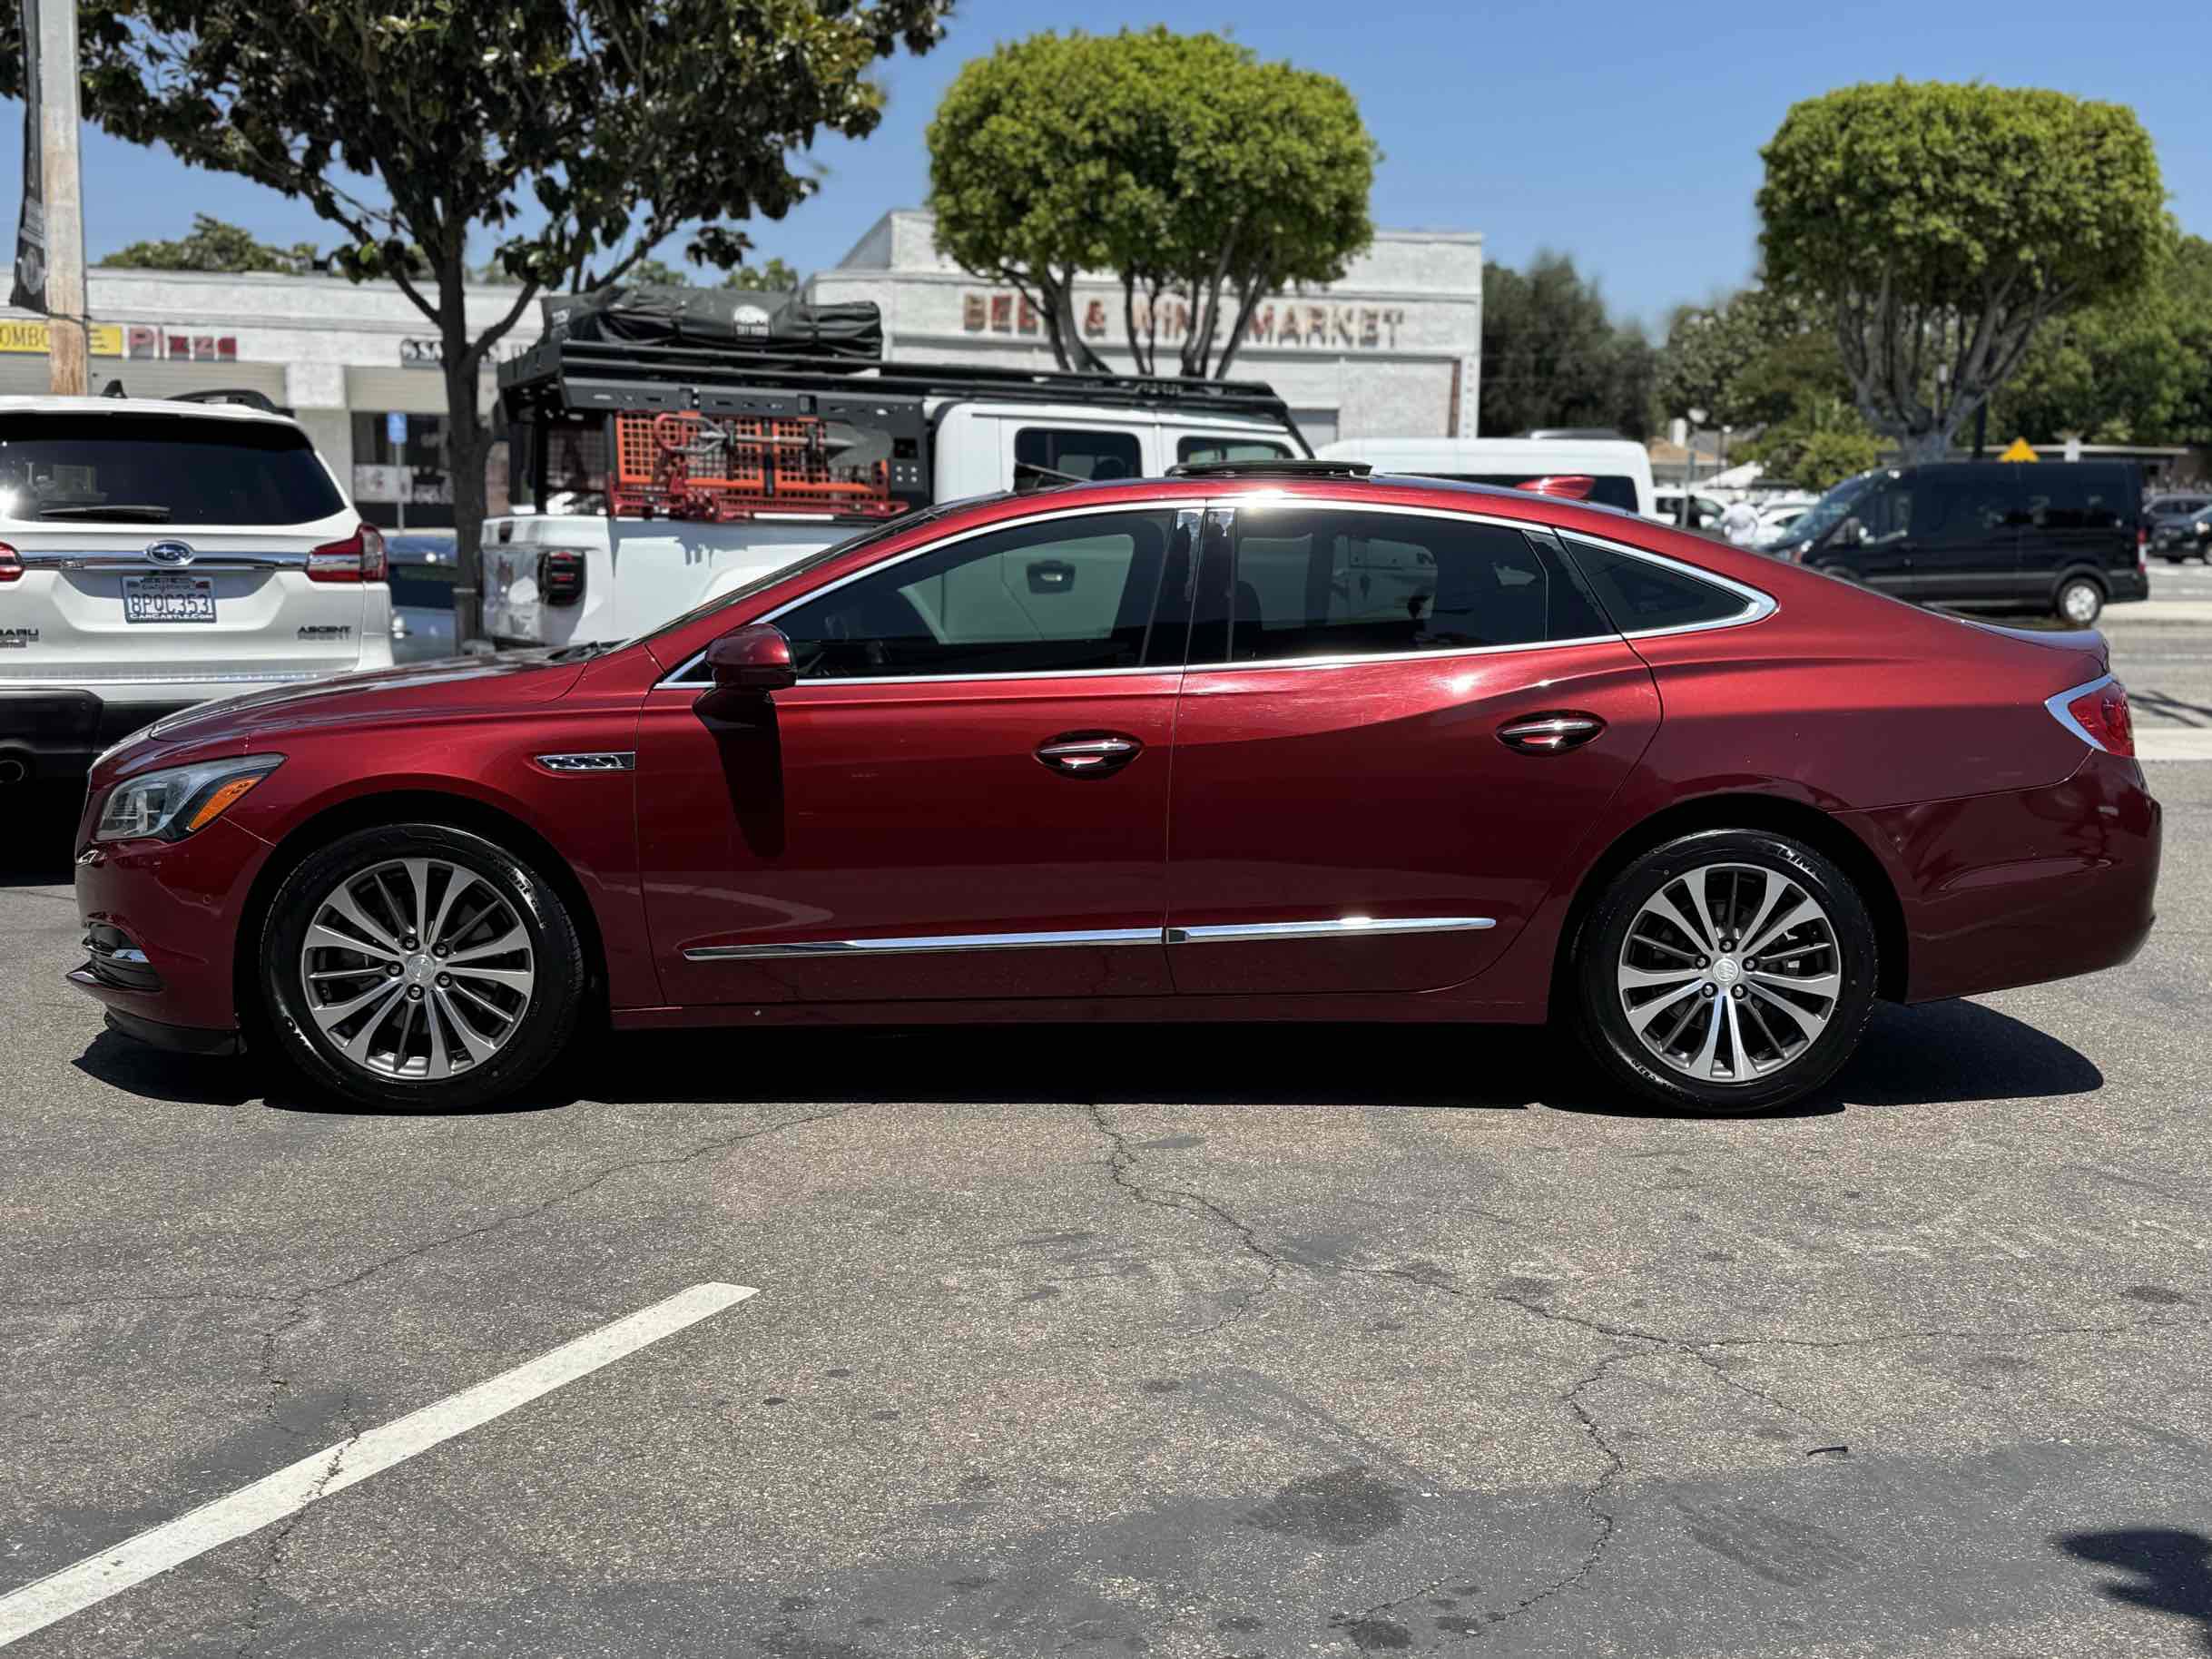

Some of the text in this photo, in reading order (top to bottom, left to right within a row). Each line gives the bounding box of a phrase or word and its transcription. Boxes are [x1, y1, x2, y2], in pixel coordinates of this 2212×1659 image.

[964, 294, 1040, 334] BEE
[1083, 299, 1106, 336] &
[1247, 303, 1405, 348] MARKET
[297, 625, 351, 633] ASCENT
